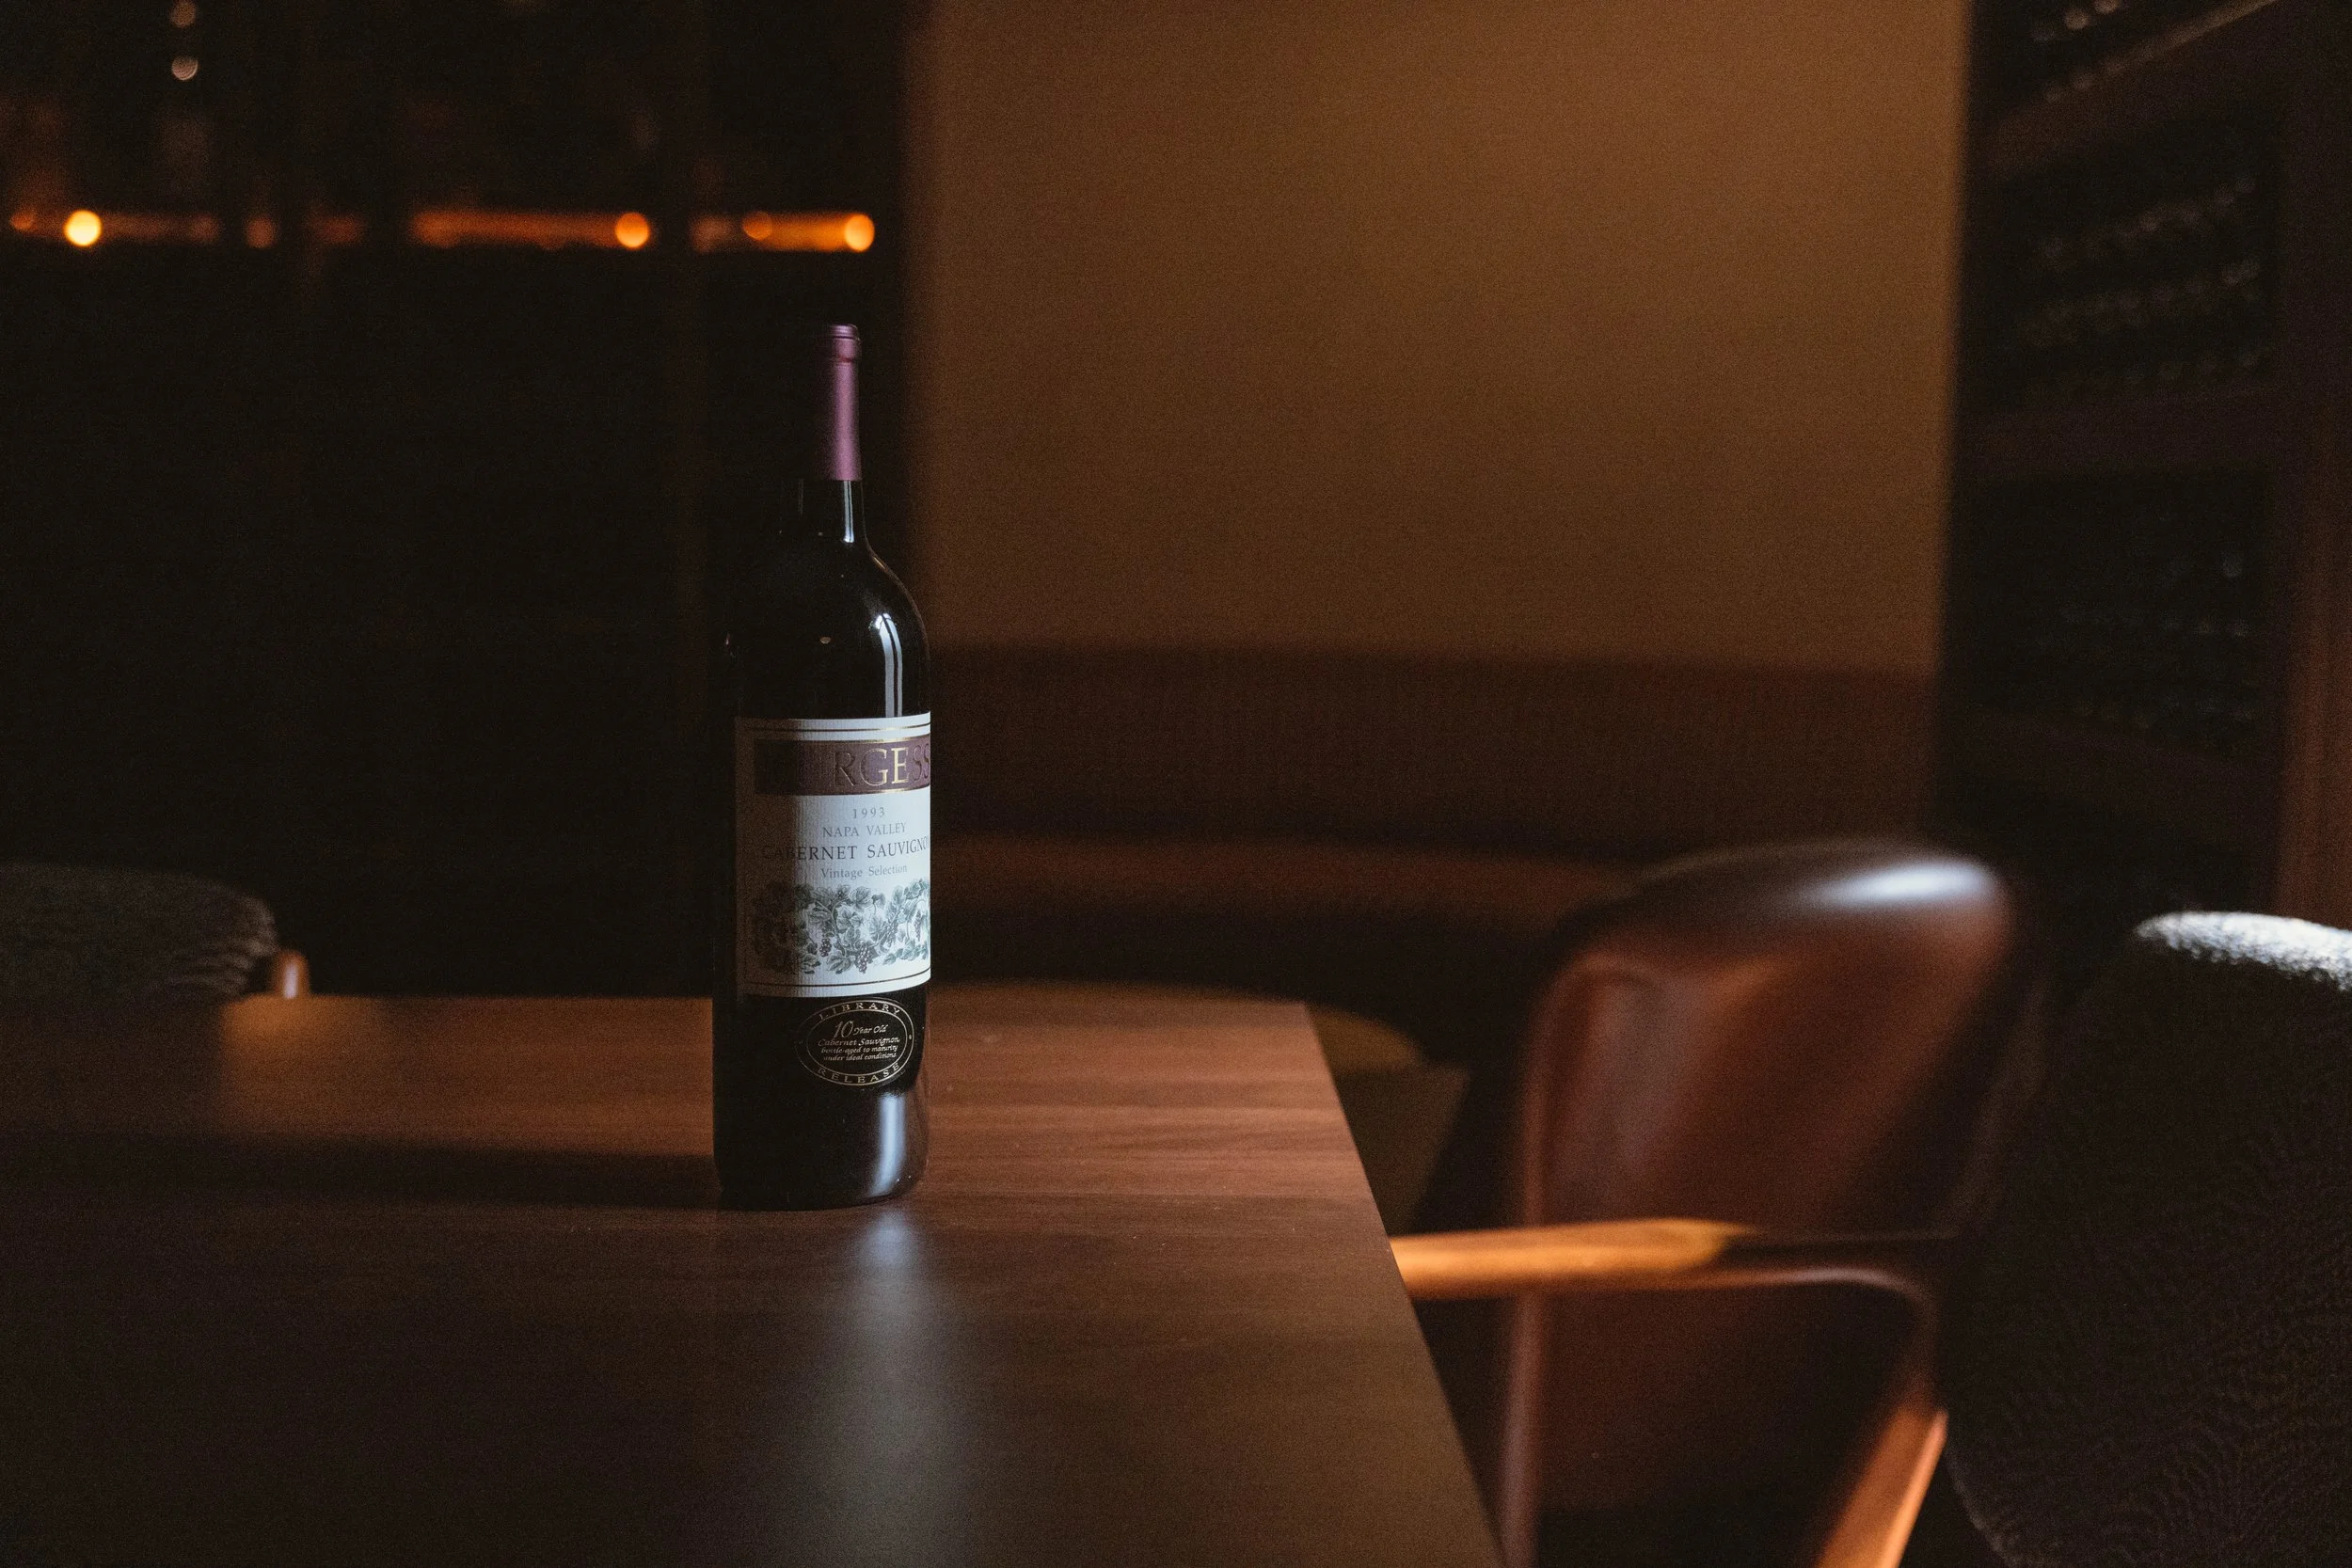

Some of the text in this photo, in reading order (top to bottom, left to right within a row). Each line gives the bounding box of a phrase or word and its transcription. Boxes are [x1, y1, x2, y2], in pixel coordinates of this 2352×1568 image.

[852, 806, 884, 819] 1993
[822, 821, 906, 837] NAPA VALLEY
[821, 865, 908, 880] Vintage Selection
[819, 1002, 900, 1020] LIBRARY
[834, 1021, 888, 1038] 10 Year Old
[818, 1037, 900, 1047] Cabernet Sauvignon
[818, 1062, 900, 1084] RELEASE
